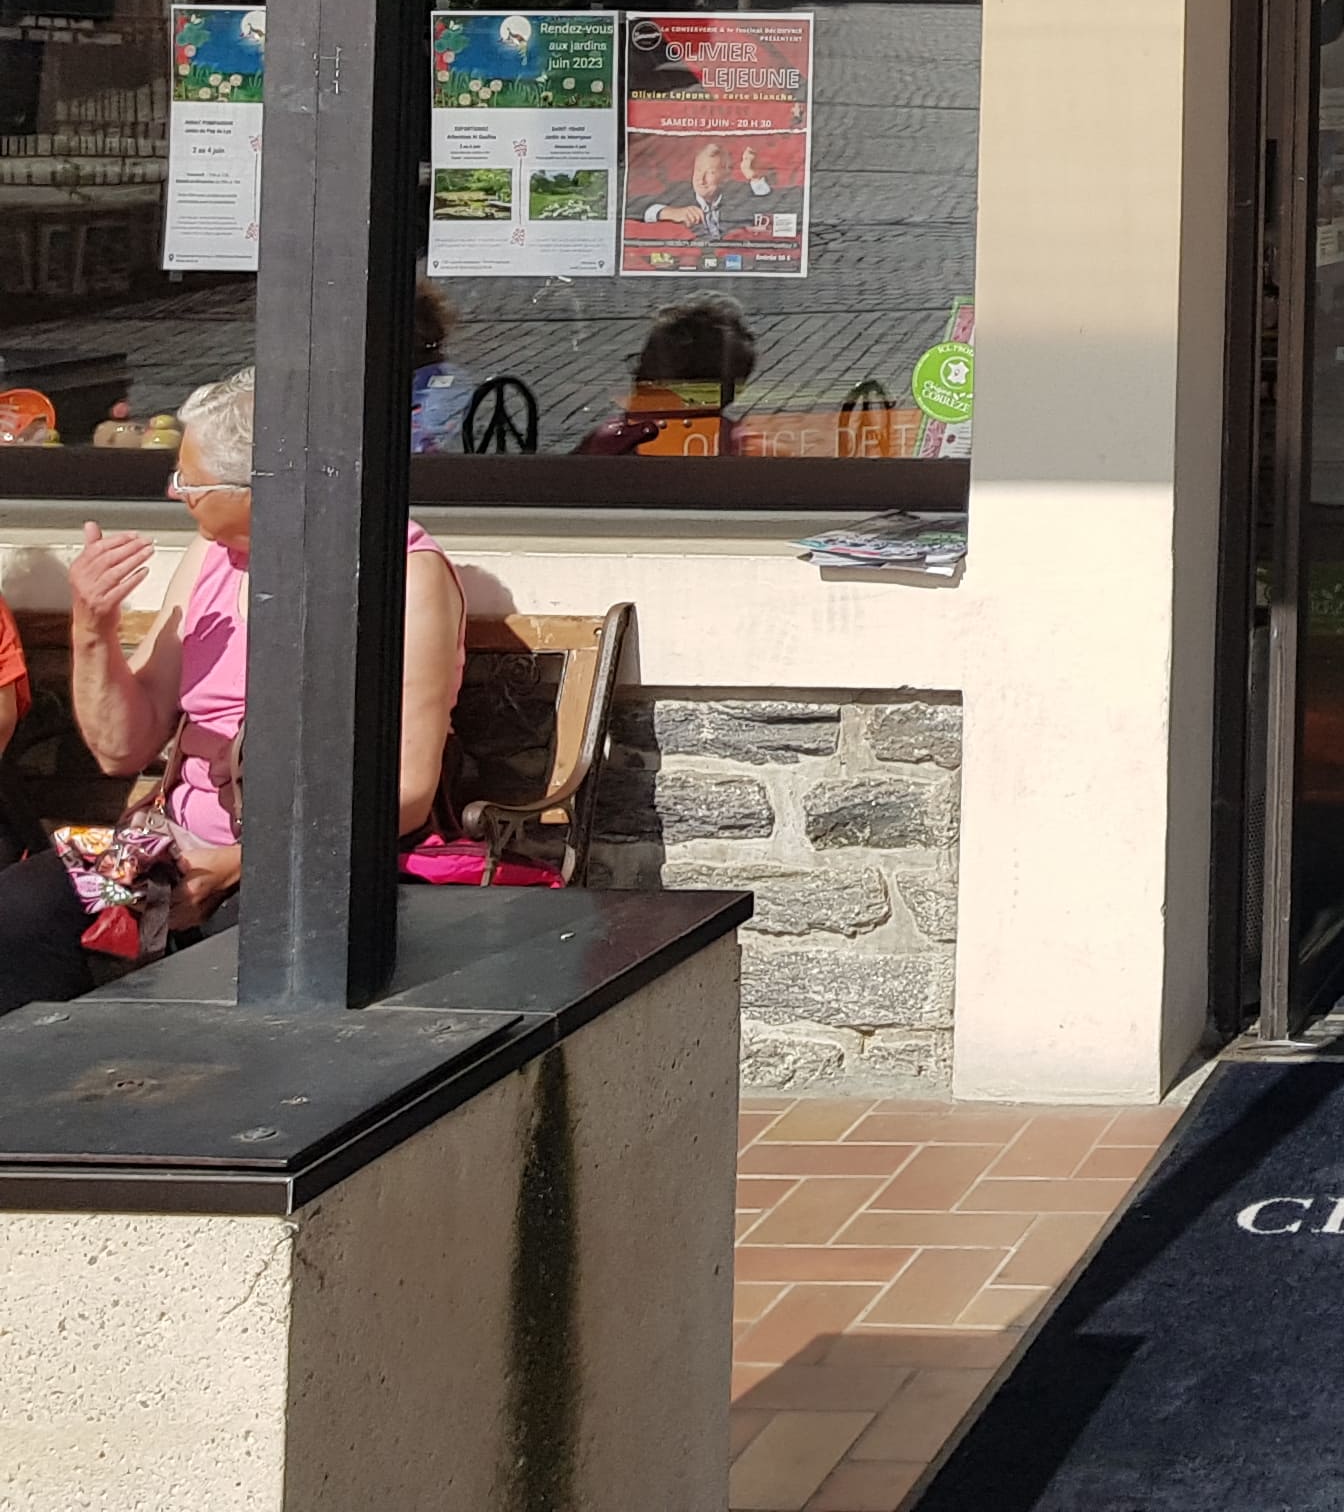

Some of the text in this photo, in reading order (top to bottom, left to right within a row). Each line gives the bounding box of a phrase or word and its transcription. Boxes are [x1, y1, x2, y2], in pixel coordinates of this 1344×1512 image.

[540, 22, 614, 34] Rendez-vous
[549, 40, 607, 53] aux jardins
[666, 42, 758, 63] OLIVIER
[548, 57, 603, 71] juin 2023
[701, 68, 800, 91] LEJEUNE
[632, 91, 666, 99] Olivier
[660, 118, 698, 127] SAMEDI
[700, 118, 705, 127] 3
[705, 118, 729, 128] JUIN
[737, 119, 748, 127] 20
[760, 119, 772, 128] 30
